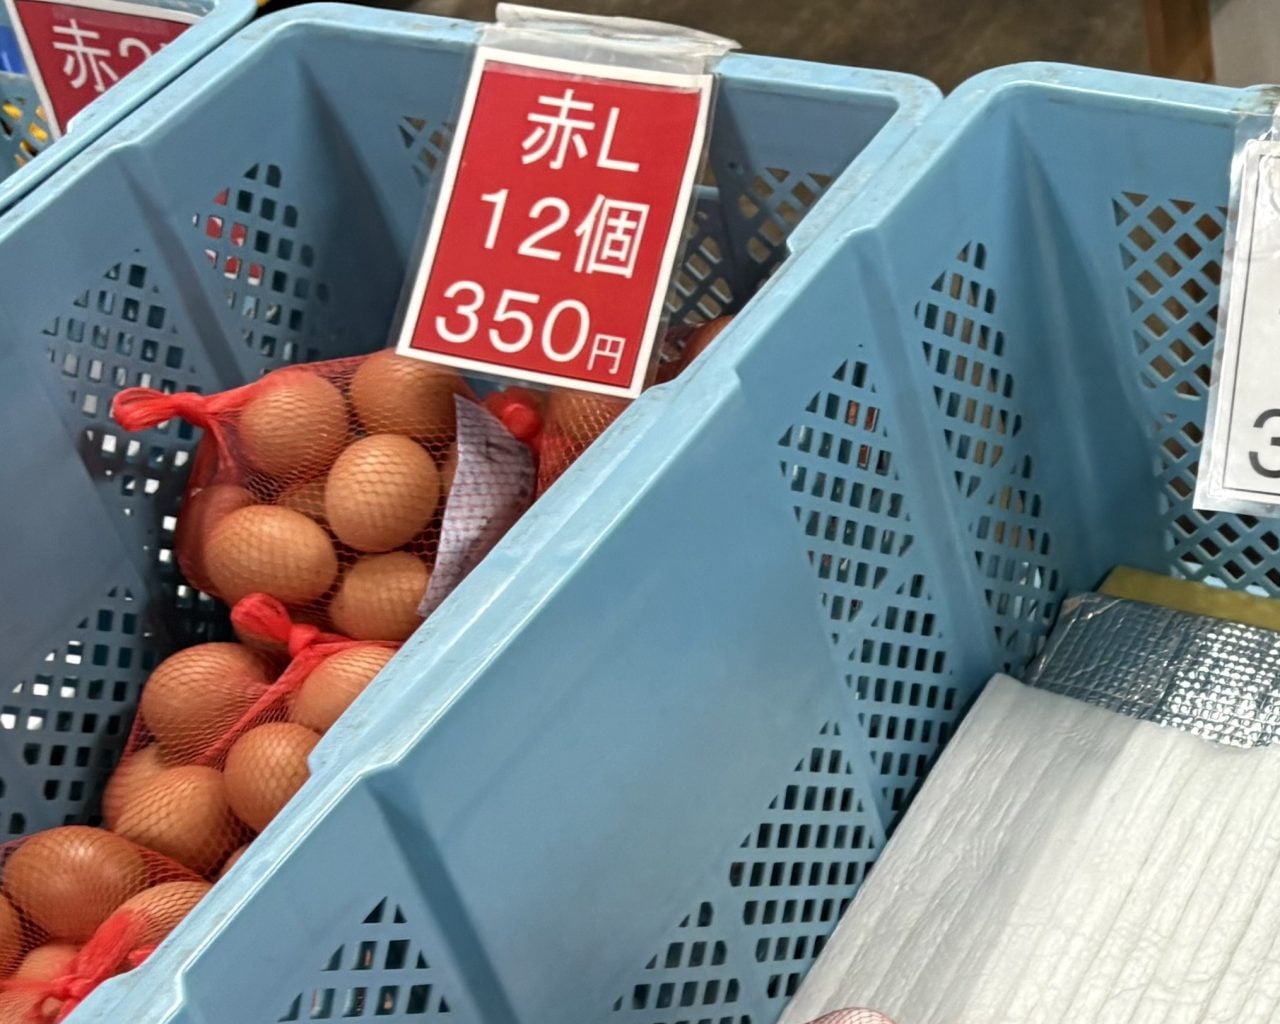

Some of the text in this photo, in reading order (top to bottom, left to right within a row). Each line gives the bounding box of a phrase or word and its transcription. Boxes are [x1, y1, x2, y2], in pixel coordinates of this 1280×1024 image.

[521, 88, 640, 173] 赤L
[481, 188, 650, 279] 12個
[435, 280, 626, 374] 350円
